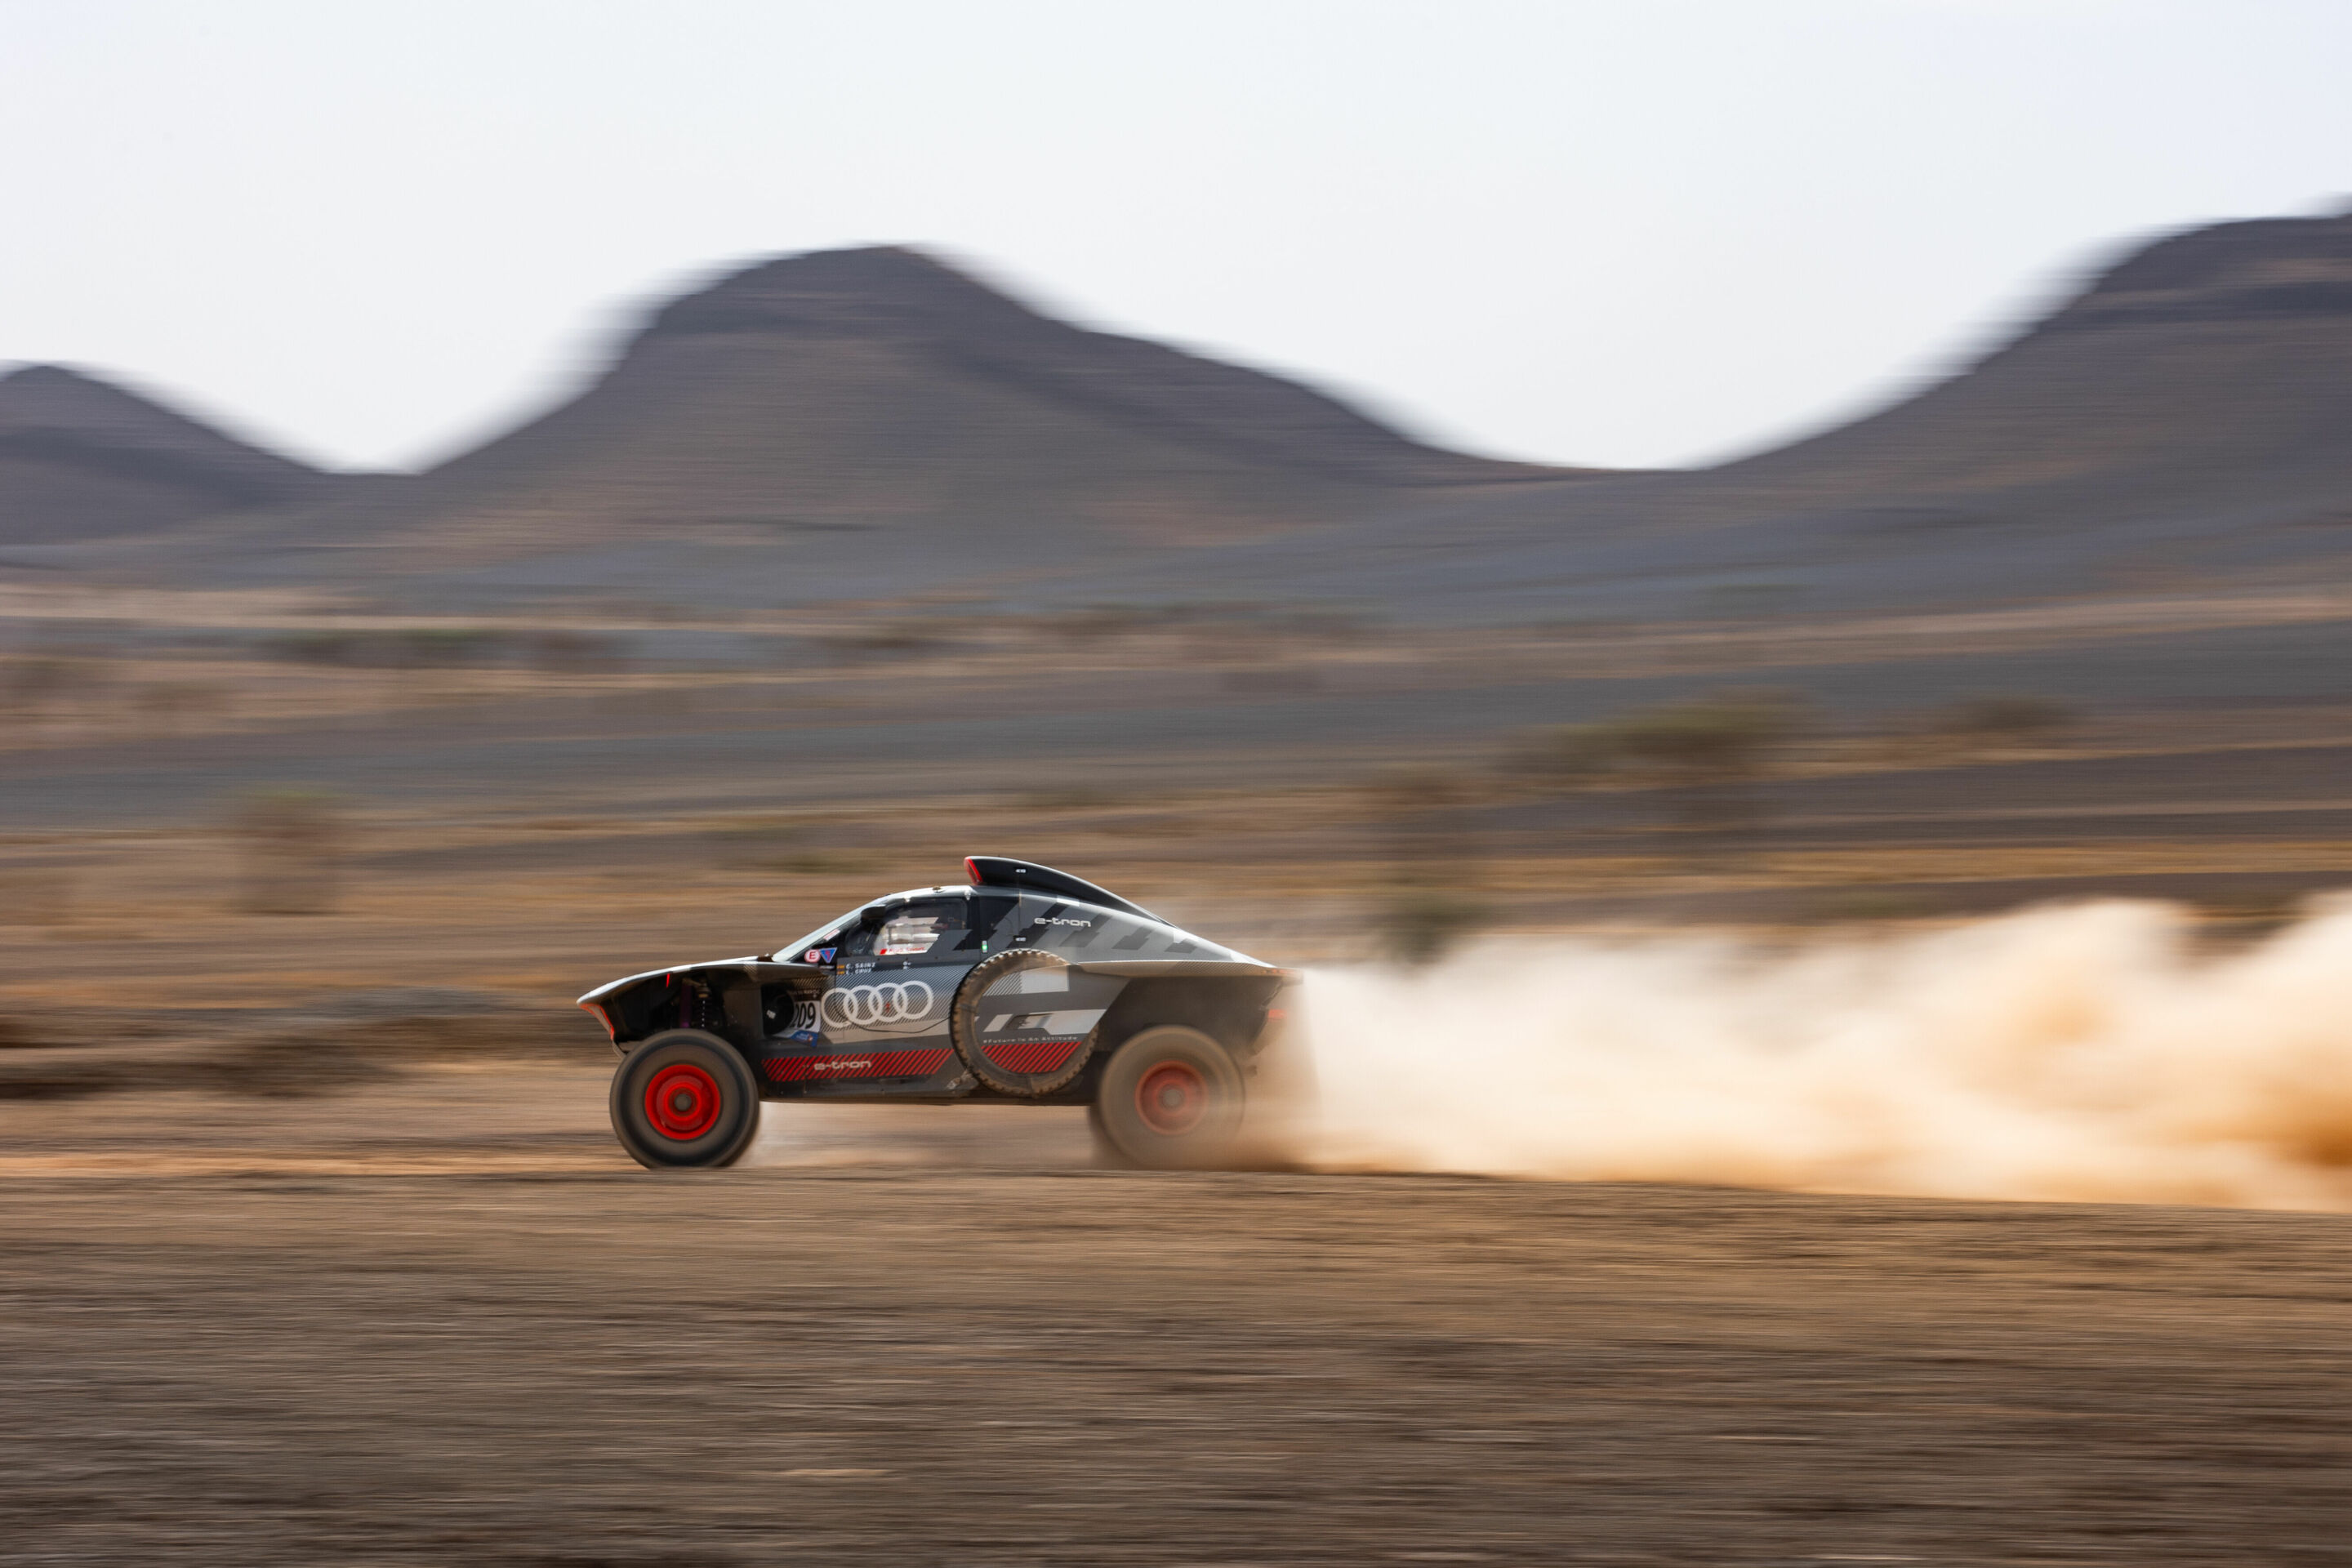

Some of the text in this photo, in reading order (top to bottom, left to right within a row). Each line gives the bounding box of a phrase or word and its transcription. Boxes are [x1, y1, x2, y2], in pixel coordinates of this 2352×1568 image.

[1034, 917, 1092, 928] e-tron
[808, 951, 815, 960] E
[814, 1061, 871, 1071] e-tron
